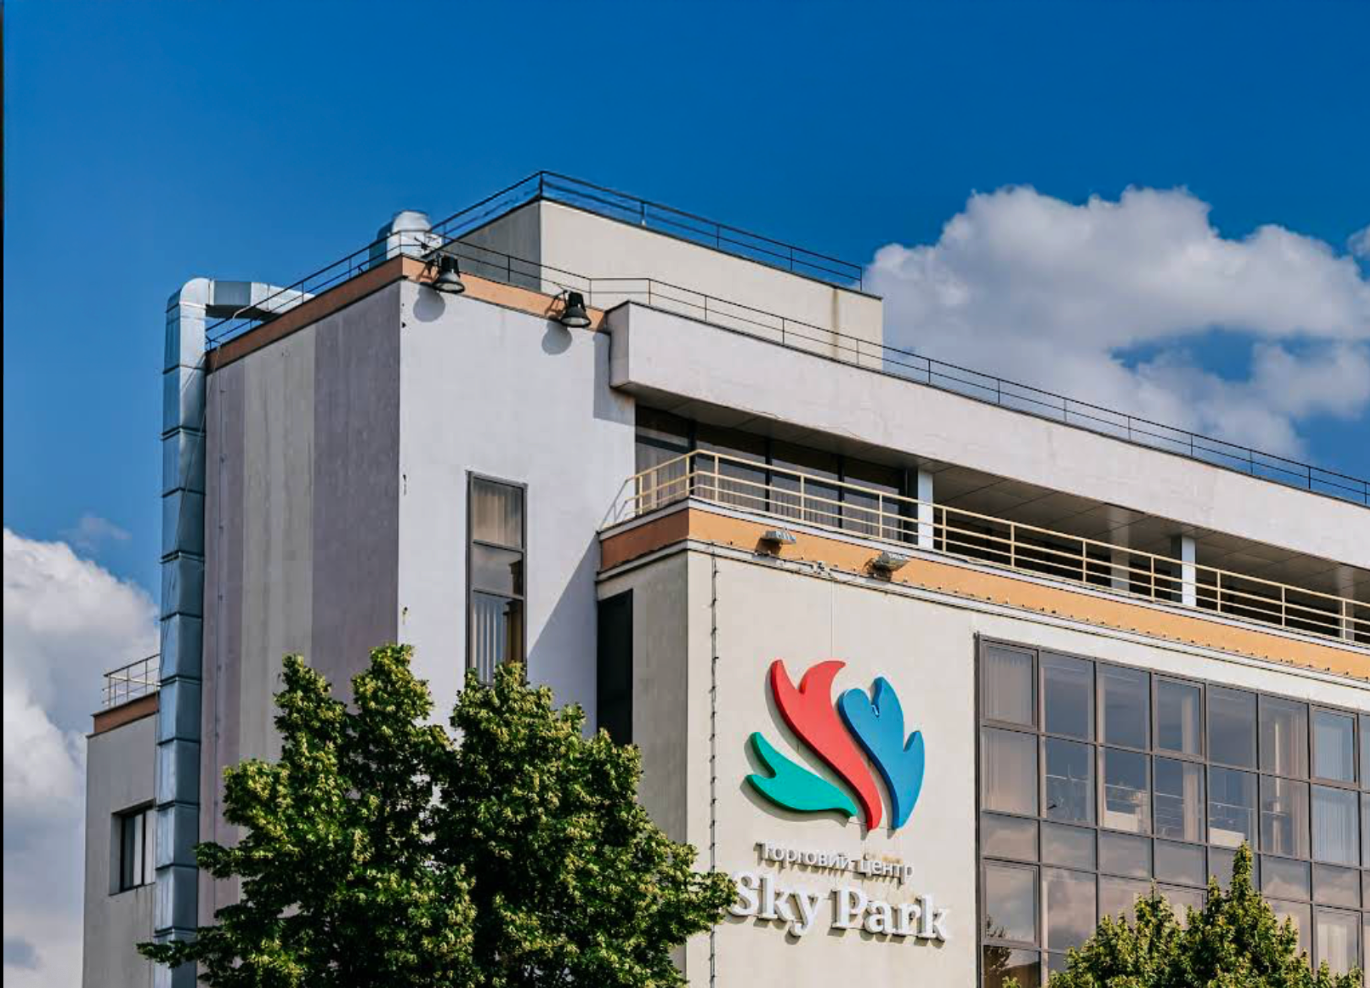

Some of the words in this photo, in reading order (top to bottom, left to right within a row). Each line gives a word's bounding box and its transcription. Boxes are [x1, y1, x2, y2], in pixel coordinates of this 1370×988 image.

[755, 841, 851, 869] Торговий
[860, 858, 914, 882] центр
[730, 871, 824, 937] Sky
[832, 884, 949, 942] Park
